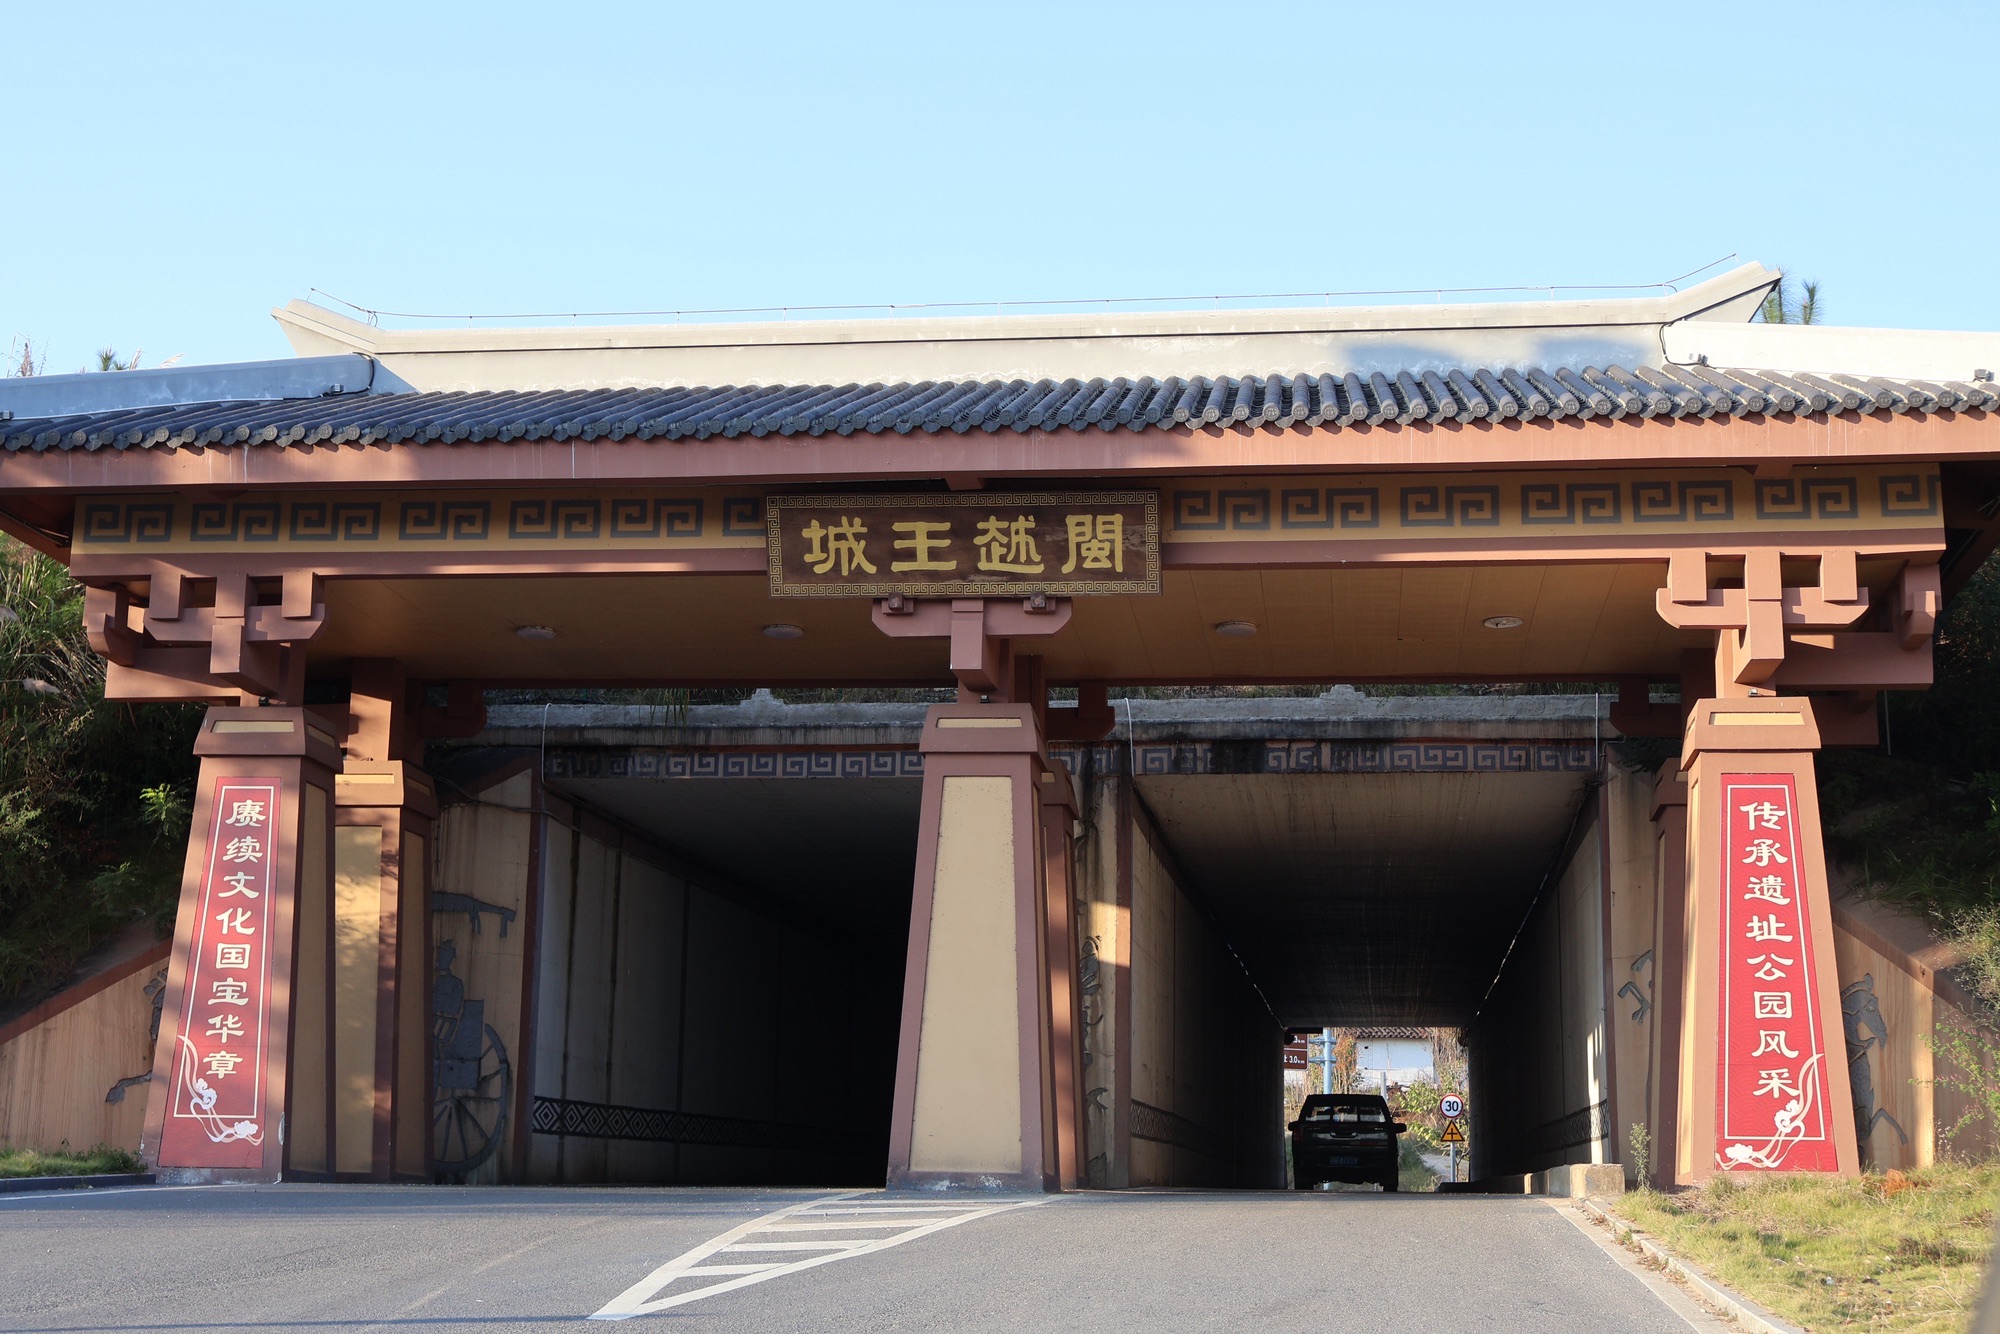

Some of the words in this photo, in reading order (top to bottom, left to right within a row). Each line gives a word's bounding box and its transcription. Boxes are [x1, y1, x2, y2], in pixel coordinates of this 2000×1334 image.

[202, 799, 267, 1080] 赓续文化国宝华章
[1739, 801, 1800, 1099] 传承遗址公园风采
[1445, 1100, 1459, 1112] 30
